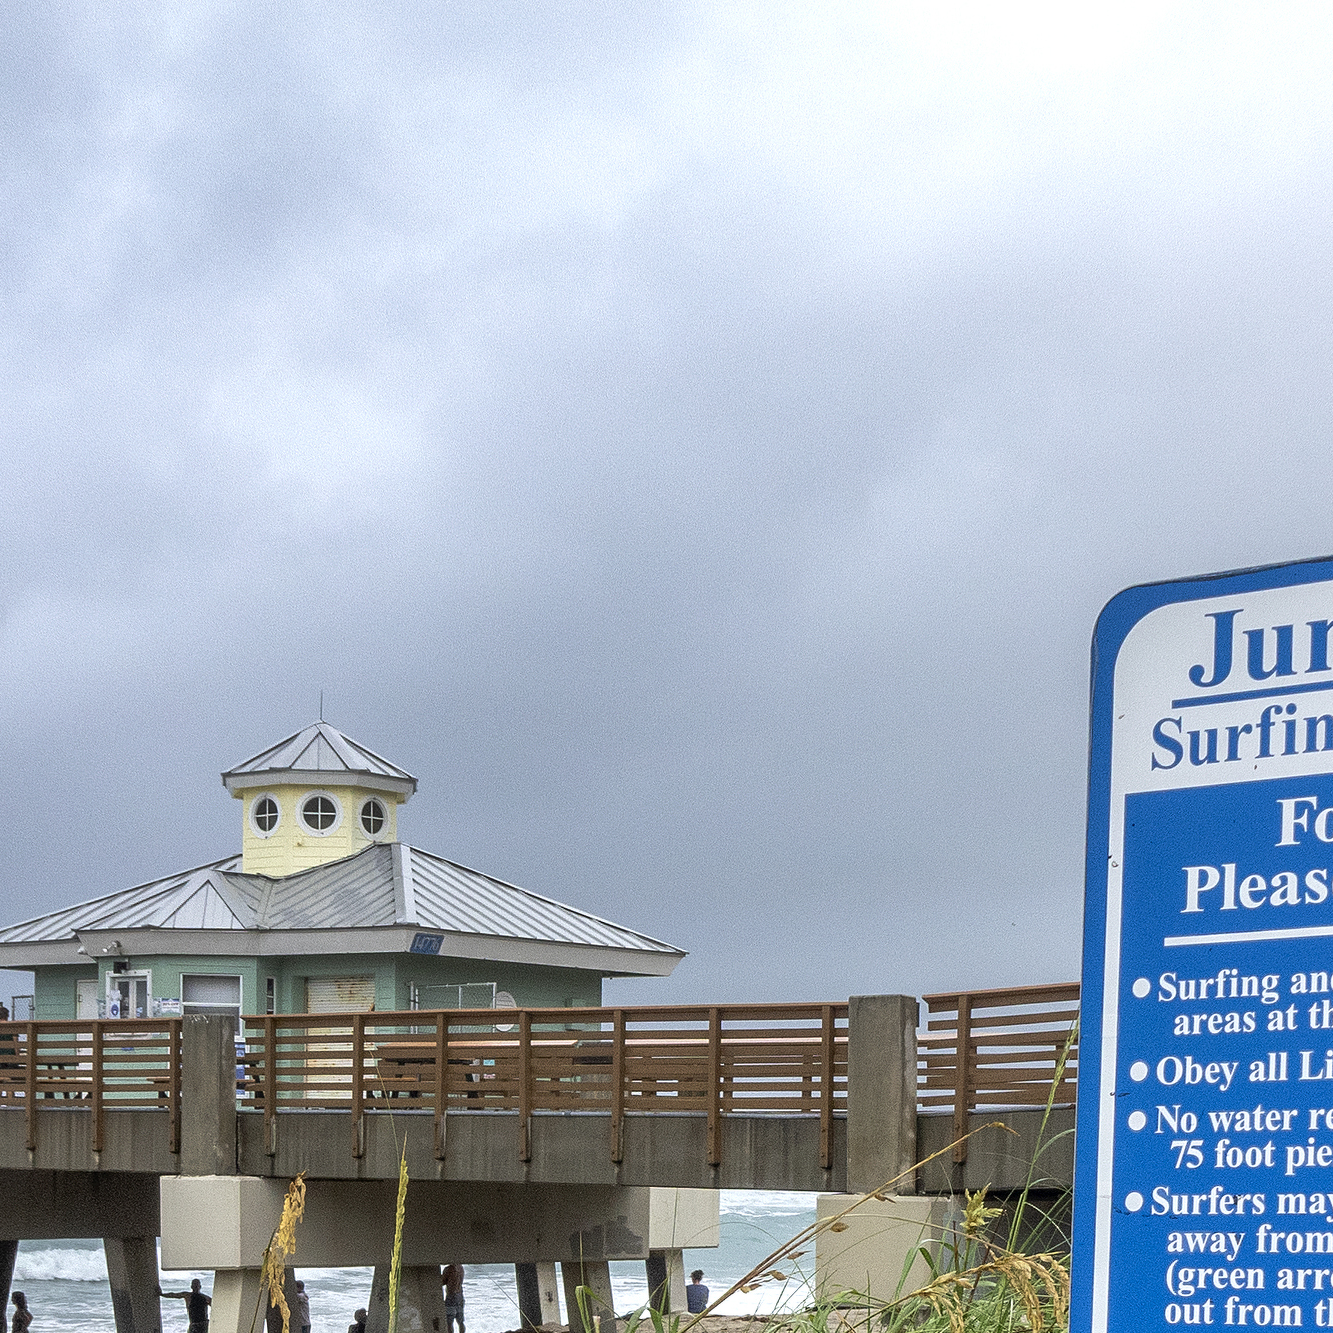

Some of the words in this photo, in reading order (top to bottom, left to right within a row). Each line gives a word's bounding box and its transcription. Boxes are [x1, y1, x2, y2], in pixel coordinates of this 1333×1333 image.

[1158, 968, 1280, 1005] Surfing
[1173, 1011, 1256, 1036] areas
[1267, 1003, 1298, 1031] at
[1156, 1055, 1239, 1092] Obey
[1248, 1052, 1288, 1082] all
[1154, 1104, 1198, 1134] No
[1207, 1104, 1298, 1133] water
[1170, 1139, 1204, 1169] 75
[1214, 1138, 1276, 1168] foot
